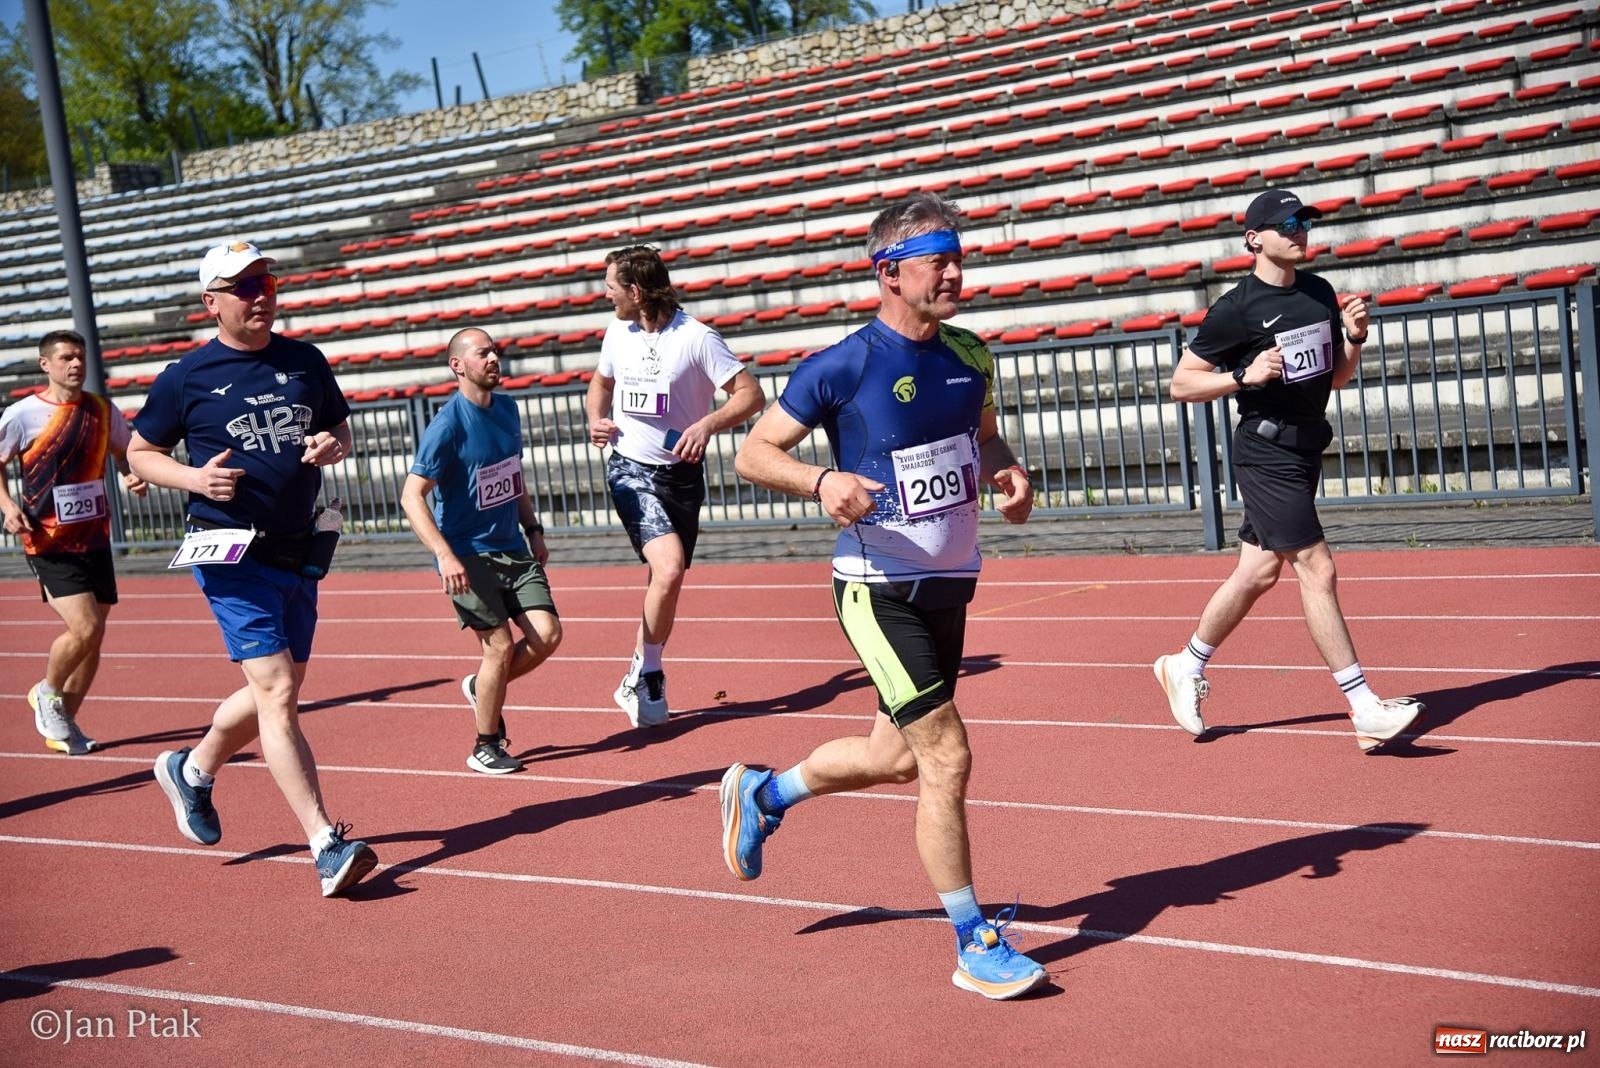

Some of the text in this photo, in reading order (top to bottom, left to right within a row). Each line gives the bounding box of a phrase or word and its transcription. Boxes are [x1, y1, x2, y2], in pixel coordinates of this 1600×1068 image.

[1294, 348, 1318, 371] 211
[629, 392, 648, 408] 117
[248, 406, 300, 454] 42
[240, 431, 267, 452] 21
[916, 451, 930, 461] BIEG
[930, 448, 939, 457] BEZ
[485, 478, 511, 500] 220
[911, 470, 960, 505] 209
[64, 499, 93, 516] 229
[190, 544, 219, 560] 171
